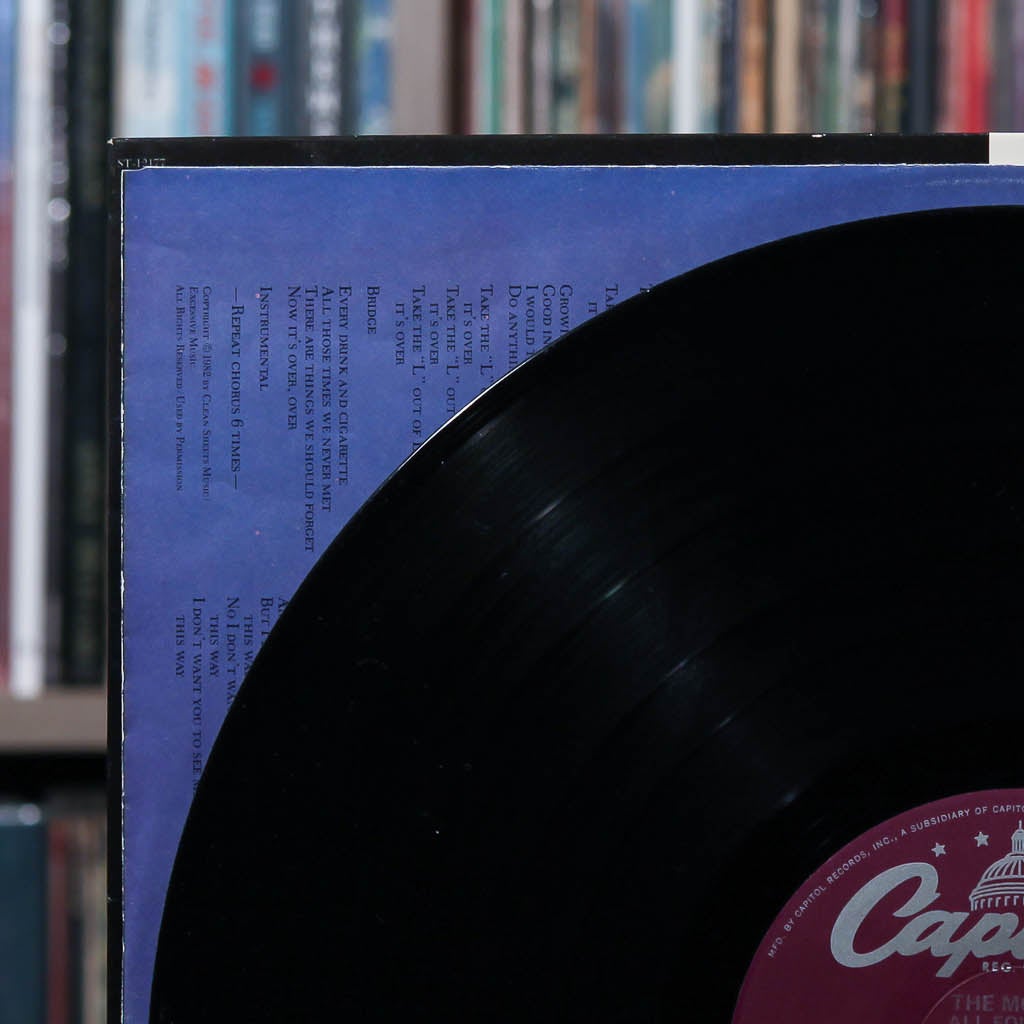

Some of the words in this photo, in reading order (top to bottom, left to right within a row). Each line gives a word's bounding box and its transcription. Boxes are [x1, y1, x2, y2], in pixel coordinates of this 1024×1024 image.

[288, 286, 301, 320] NOW
[305, 285, 318, 331] THERE
[322, 287, 334, 314] ALL
[339, 287, 352, 329] EVERY
[367, 287, 380, 334] BRIDGE
[260, 287, 272, 391] INSTRUMENTAL
[288, 327, 301, 349] IT'S
[305, 336, 314, 360] ARE
[322, 319, 331, 362] THOSE
[339, 335, 348, 375] DRINK
[231, 362, 240, 414] CHORUS
[288, 354, 297, 392] OVER,
[305, 364, 314, 415] THINGS
[322, 367, 331, 407] TIMES
[339, 380, 348, 408] AND
[231, 419, 243, 427] 6
[288, 397, 297, 430] OVER
[305, 420, 314, 440] WE
[322, 412, 331, 432] WE
[322, 438, 331, 479] NEVER
[339, 412, 348, 485] CIGARETTE
[305, 445, 314, 499] SHOULD
[322, 485, 331, 512] MET
[305, 504, 314, 552] FORGET
[176, 616, 184, 645] THIS
[192, 608, 205, 649] DON'T
[176, 651, 184, 677] WAY
[193, 654, 202, 693] WANT
[193, 698, 201, 725] YOU
[193, 730, 201, 748] TO
[783, 918, 793, 932] BY
[794, 884, 827, 918] CAPITOL
[827, 850, 871, 884] RECORDS,
[901, 829, 908, 837] A
[910, 809, 970, 833] SUBSIDIARY
[975, 807, 988, 815] OF
[952, 995, 992, 1011] THE
